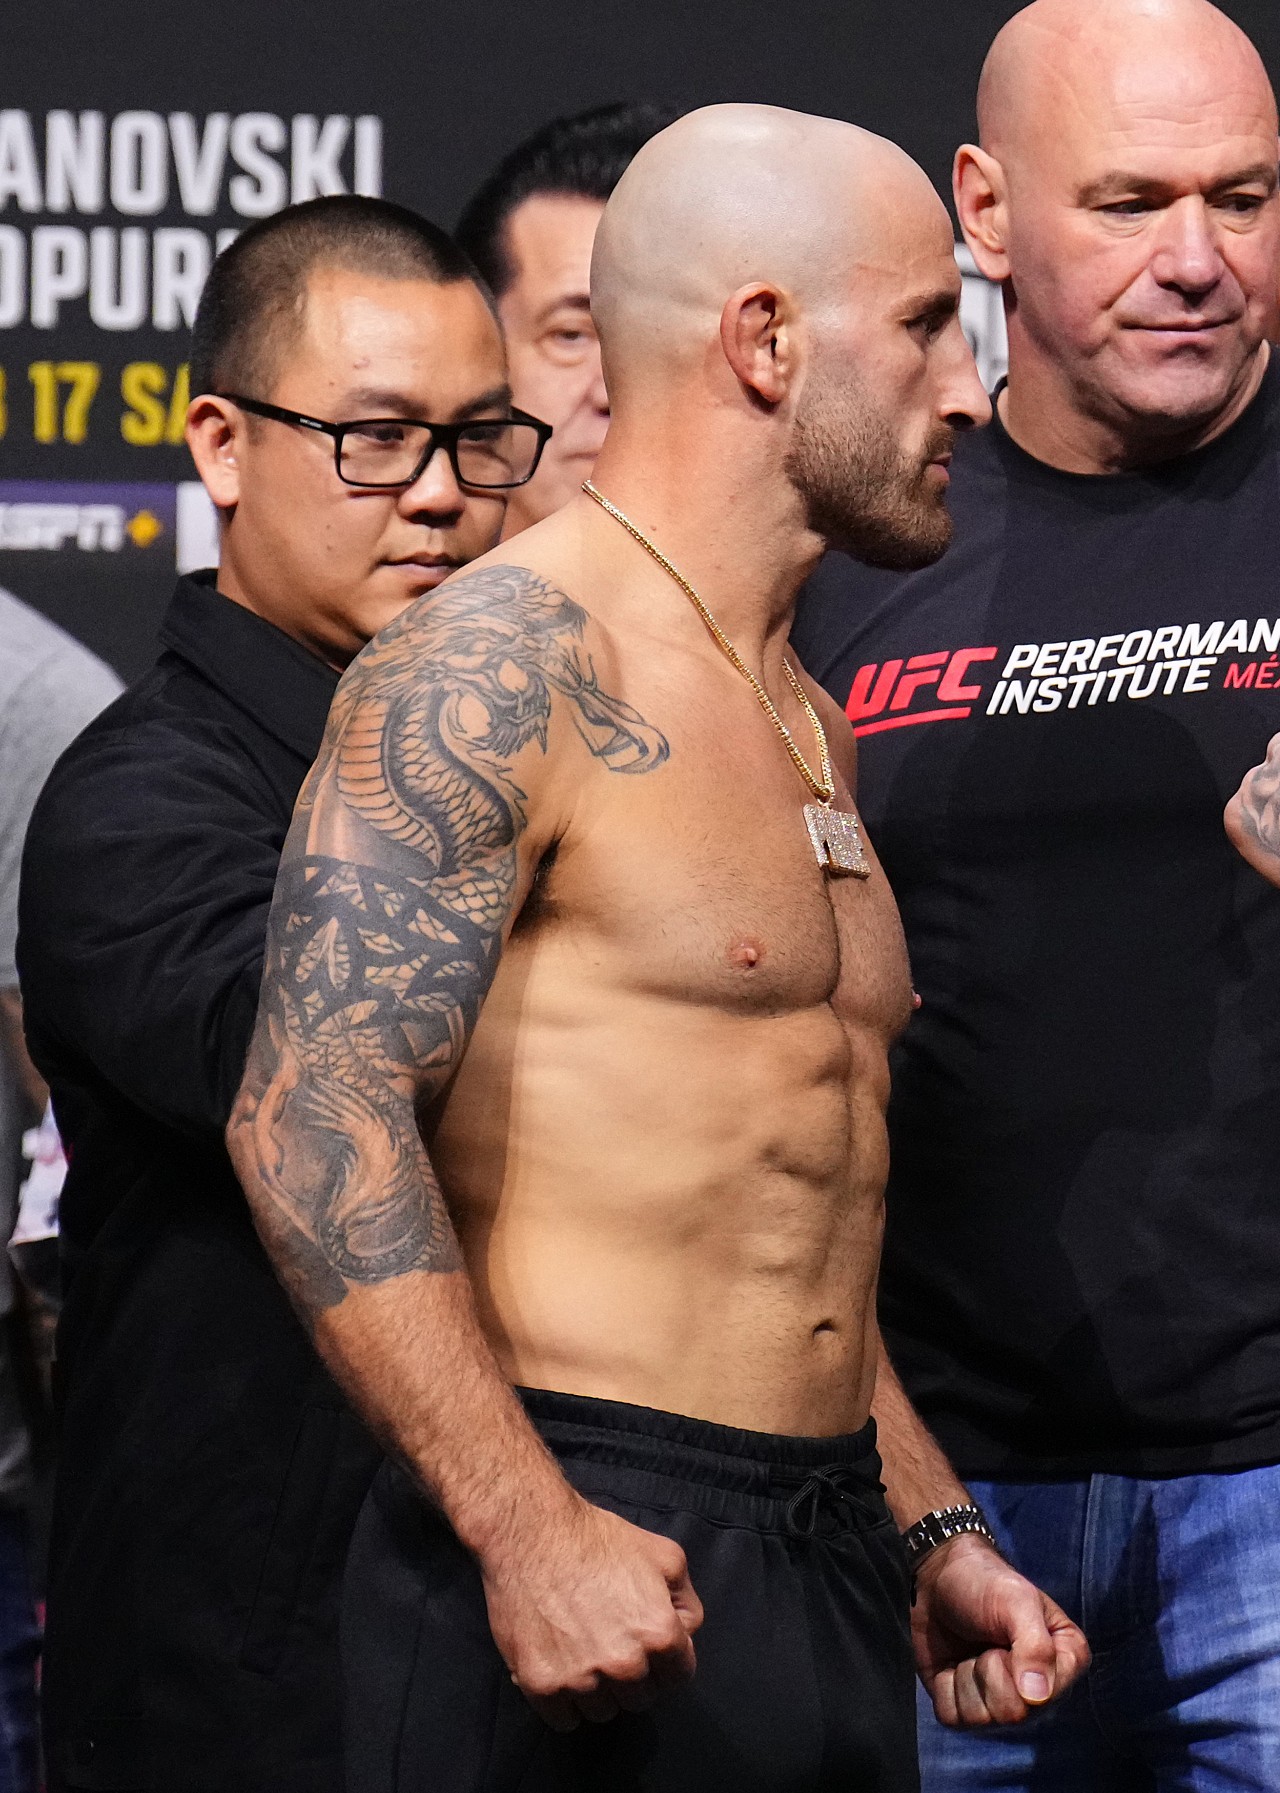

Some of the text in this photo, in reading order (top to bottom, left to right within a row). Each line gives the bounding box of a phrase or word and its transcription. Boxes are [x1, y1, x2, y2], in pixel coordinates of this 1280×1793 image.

[28, 361, 98, 444] 17
[845, 646, 999, 723] UFC
[985, 656, 1218, 716] INSTITUTE
